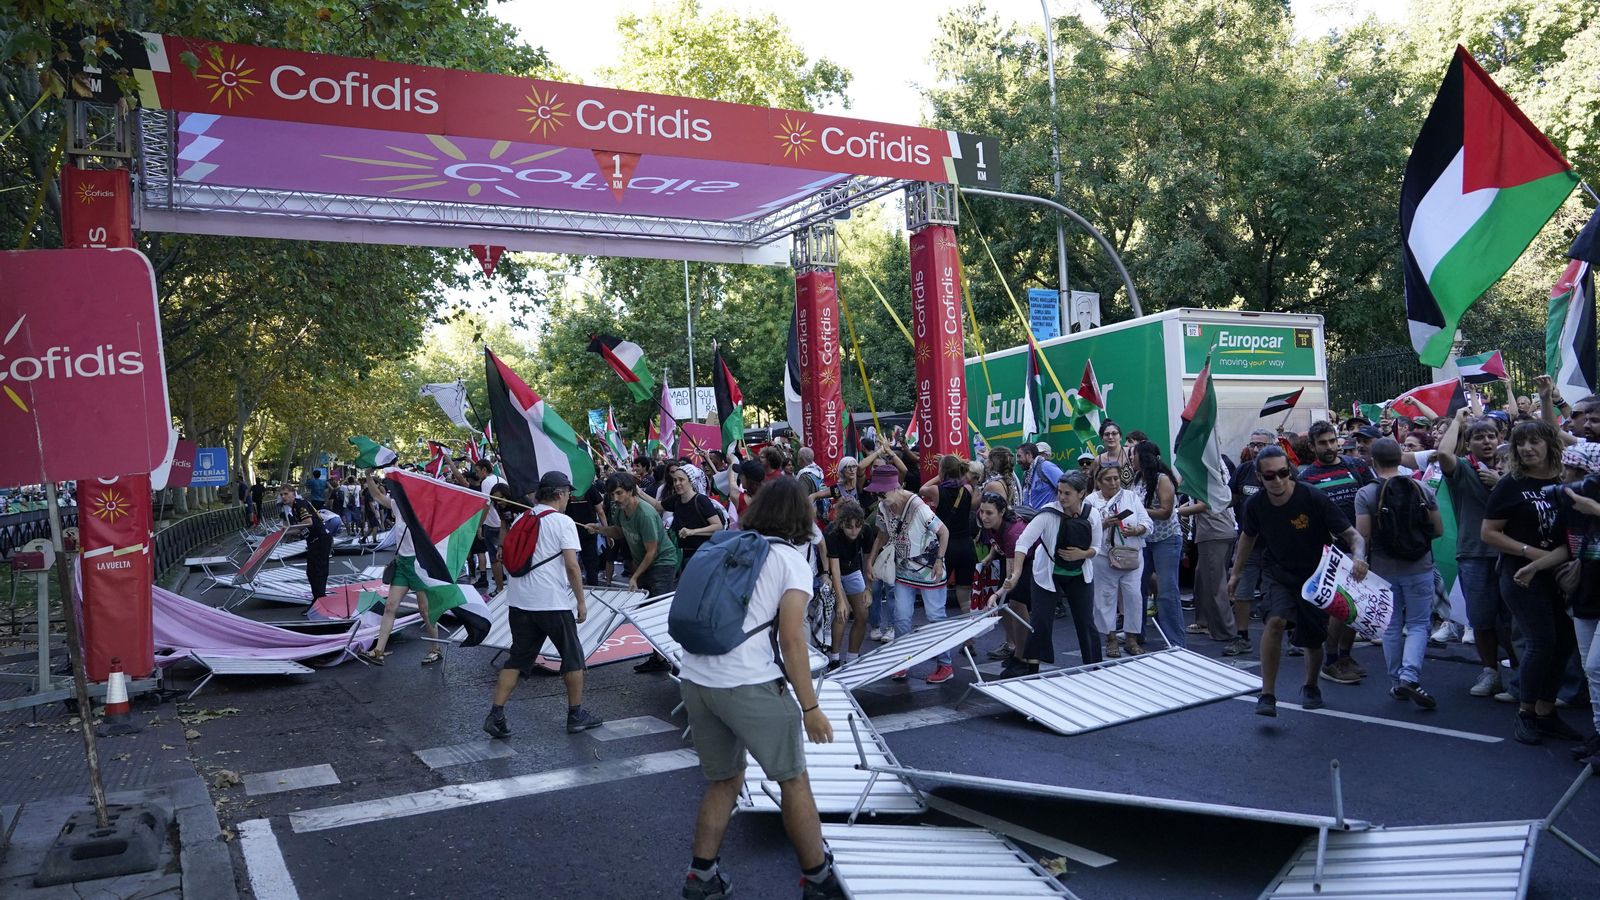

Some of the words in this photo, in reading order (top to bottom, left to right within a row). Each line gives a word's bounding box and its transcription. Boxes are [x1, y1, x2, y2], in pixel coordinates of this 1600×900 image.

[269, 64, 439, 115] Cofidis
[576, 99, 713, 142] Cofidis
[612, 154, 623, 178] 1
[820, 126, 931, 166] Cofidis
[975, 141, 987, 168] 1
[84, 189, 114, 197] Cofidis
[612, 180, 623, 189] KM
[977, 170, 987, 181] KM
[914, 270, 926, 339] Cofidis
[942, 266, 958, 335] Cofidis
[799, 308, 809, 367] Cofidis
[820, 307, 832, 365] Cofidis
[1219, 331, 1284, 354] Europcar
[1219, 358, 1248, 368] moving
[1248, 360, 1266, 368] your
[1268, 359, 1285, 368] way
[675, 398, 690, 406] RID
[919, 379, 933, 448] Cofidis
[947, 377, 963, 446] Cofidis
[985, 383, 1114, 434] Eurpcr
[804, 402, 814, 448] ofidis
[825, 400, 838, 459] Cofidis
[172, 458, 192, 468] fidis
[192, 468, 226, 477] OTERÍAS
[1049, 447, 1077, 461] our
